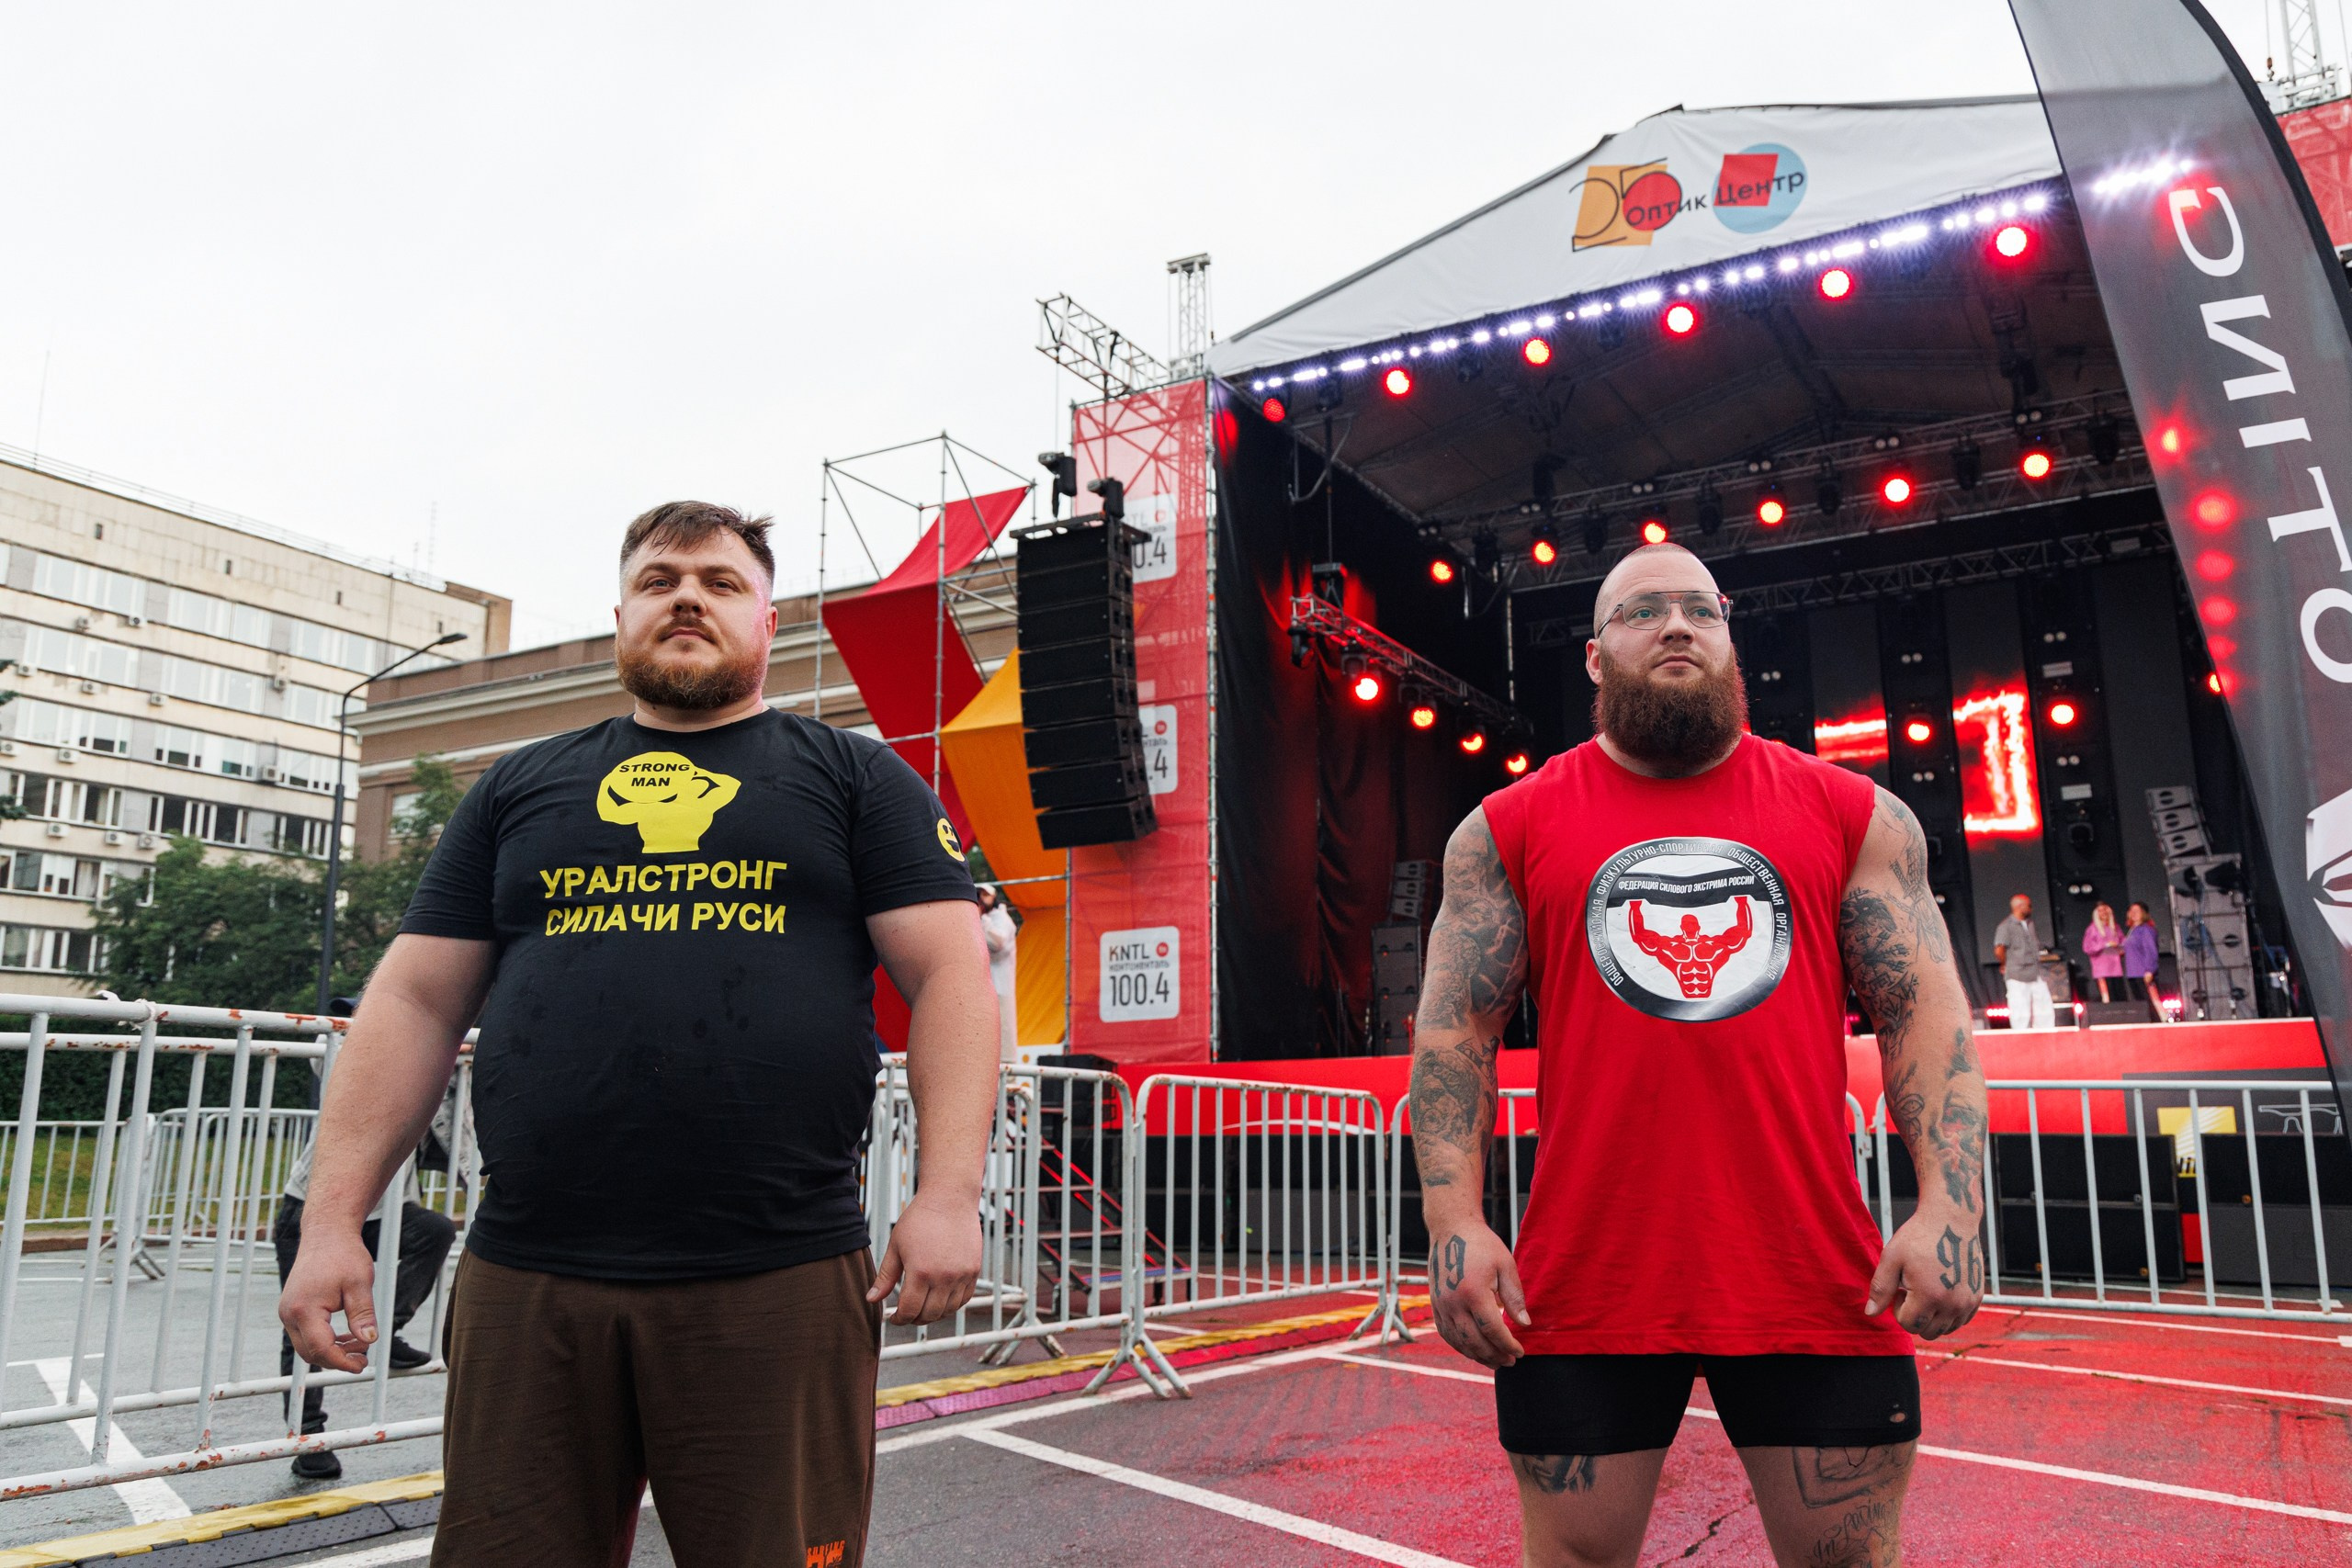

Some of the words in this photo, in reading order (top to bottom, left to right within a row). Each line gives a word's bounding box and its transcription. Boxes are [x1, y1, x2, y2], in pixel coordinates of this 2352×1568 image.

[1625, 194, 1708, 226] Оптик
[1717, 170, 1805, 205] Центр
[618, 763, 690, 773] STRONG
[630, 777, 671, 787] MAN
[539, 860, 787, 898] УРАЛСТРОНГ
[1618, 880, 1659, 891] ФЕДЕРАЦИЯ
[1659, 882, 1692, 894] СИЛОВОГО
[1692, 878, 1728, 892] ЭКСТРИМА
[1728, 874, 1755, 886] РОССИИ
[545, 903, 681, 936] СИЛАЧИ
[691, 902, 786, 934] РУСИ
[1589, 898, 1624, 987] ОБЩЕРОССИЙСКАЯ
[1727, 847, 1785, 906] ОБЩЕСТВЕННАЯ
[1767, 912, 1788, 981] ОРГАНИЗАЦИЯ
[1108, 943, 1150, 962] KNTL
[1109, 972, 1170, 1007] 100.4
[1430, 1235, 1467, 1298] 19
[1937, 1224, 1982, 1294] 96
